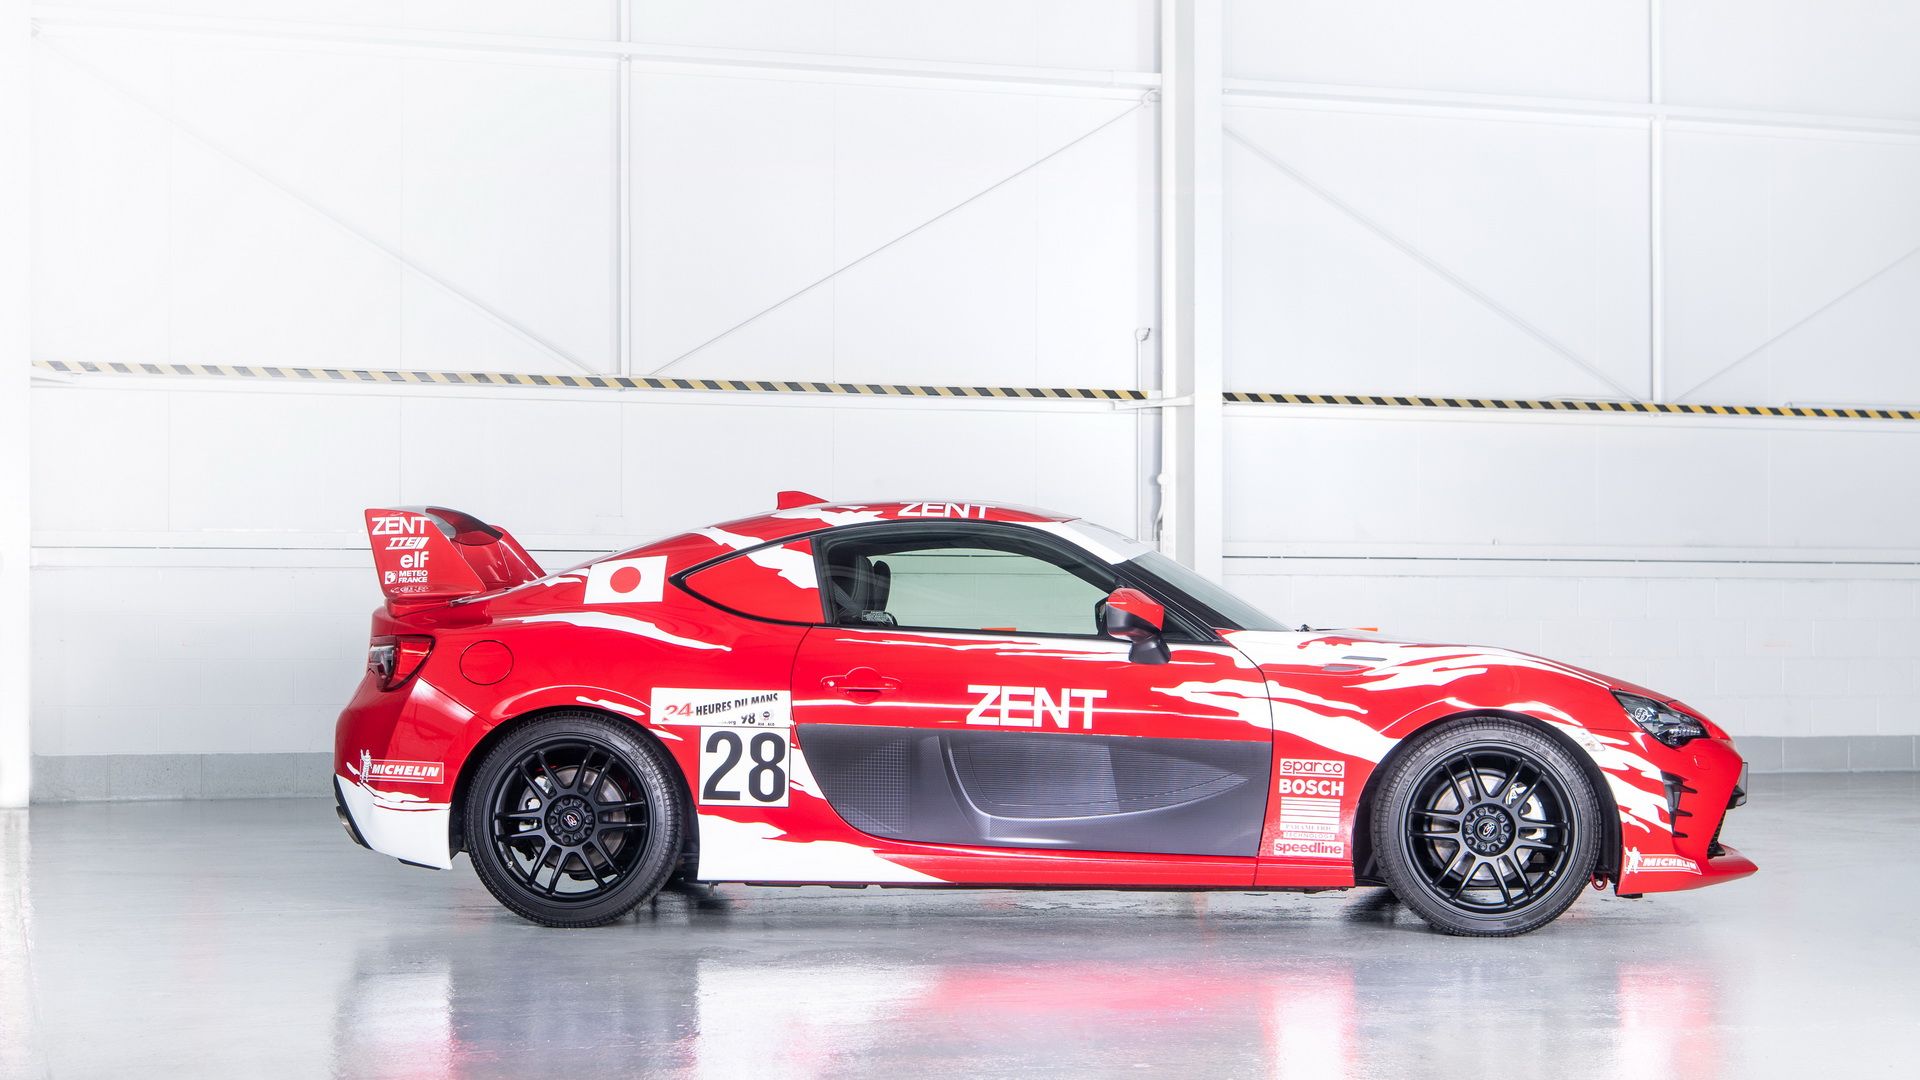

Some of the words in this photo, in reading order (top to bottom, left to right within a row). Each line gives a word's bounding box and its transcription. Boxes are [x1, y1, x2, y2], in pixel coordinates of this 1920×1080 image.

[897, 501, 996, 519] ZENT
[372, 516, 431, 535] ZENT
[400, 551, 429, 568] elf
[695, 700, 732, 716] HEURES
[750, 692, 778, 705] MANS
[966, 684, 1107, 730] ZENT
[371, 764, 440, 777] MICHELIN
[702, 730, 786, 803] 28
[1282, 760, 1343, 774] sparco
[1279, 778, 1345, 797] BOSCH
[1274, 842, 1342, 855] speedline
[1642, 857, 1697, 870] MICHELIN
